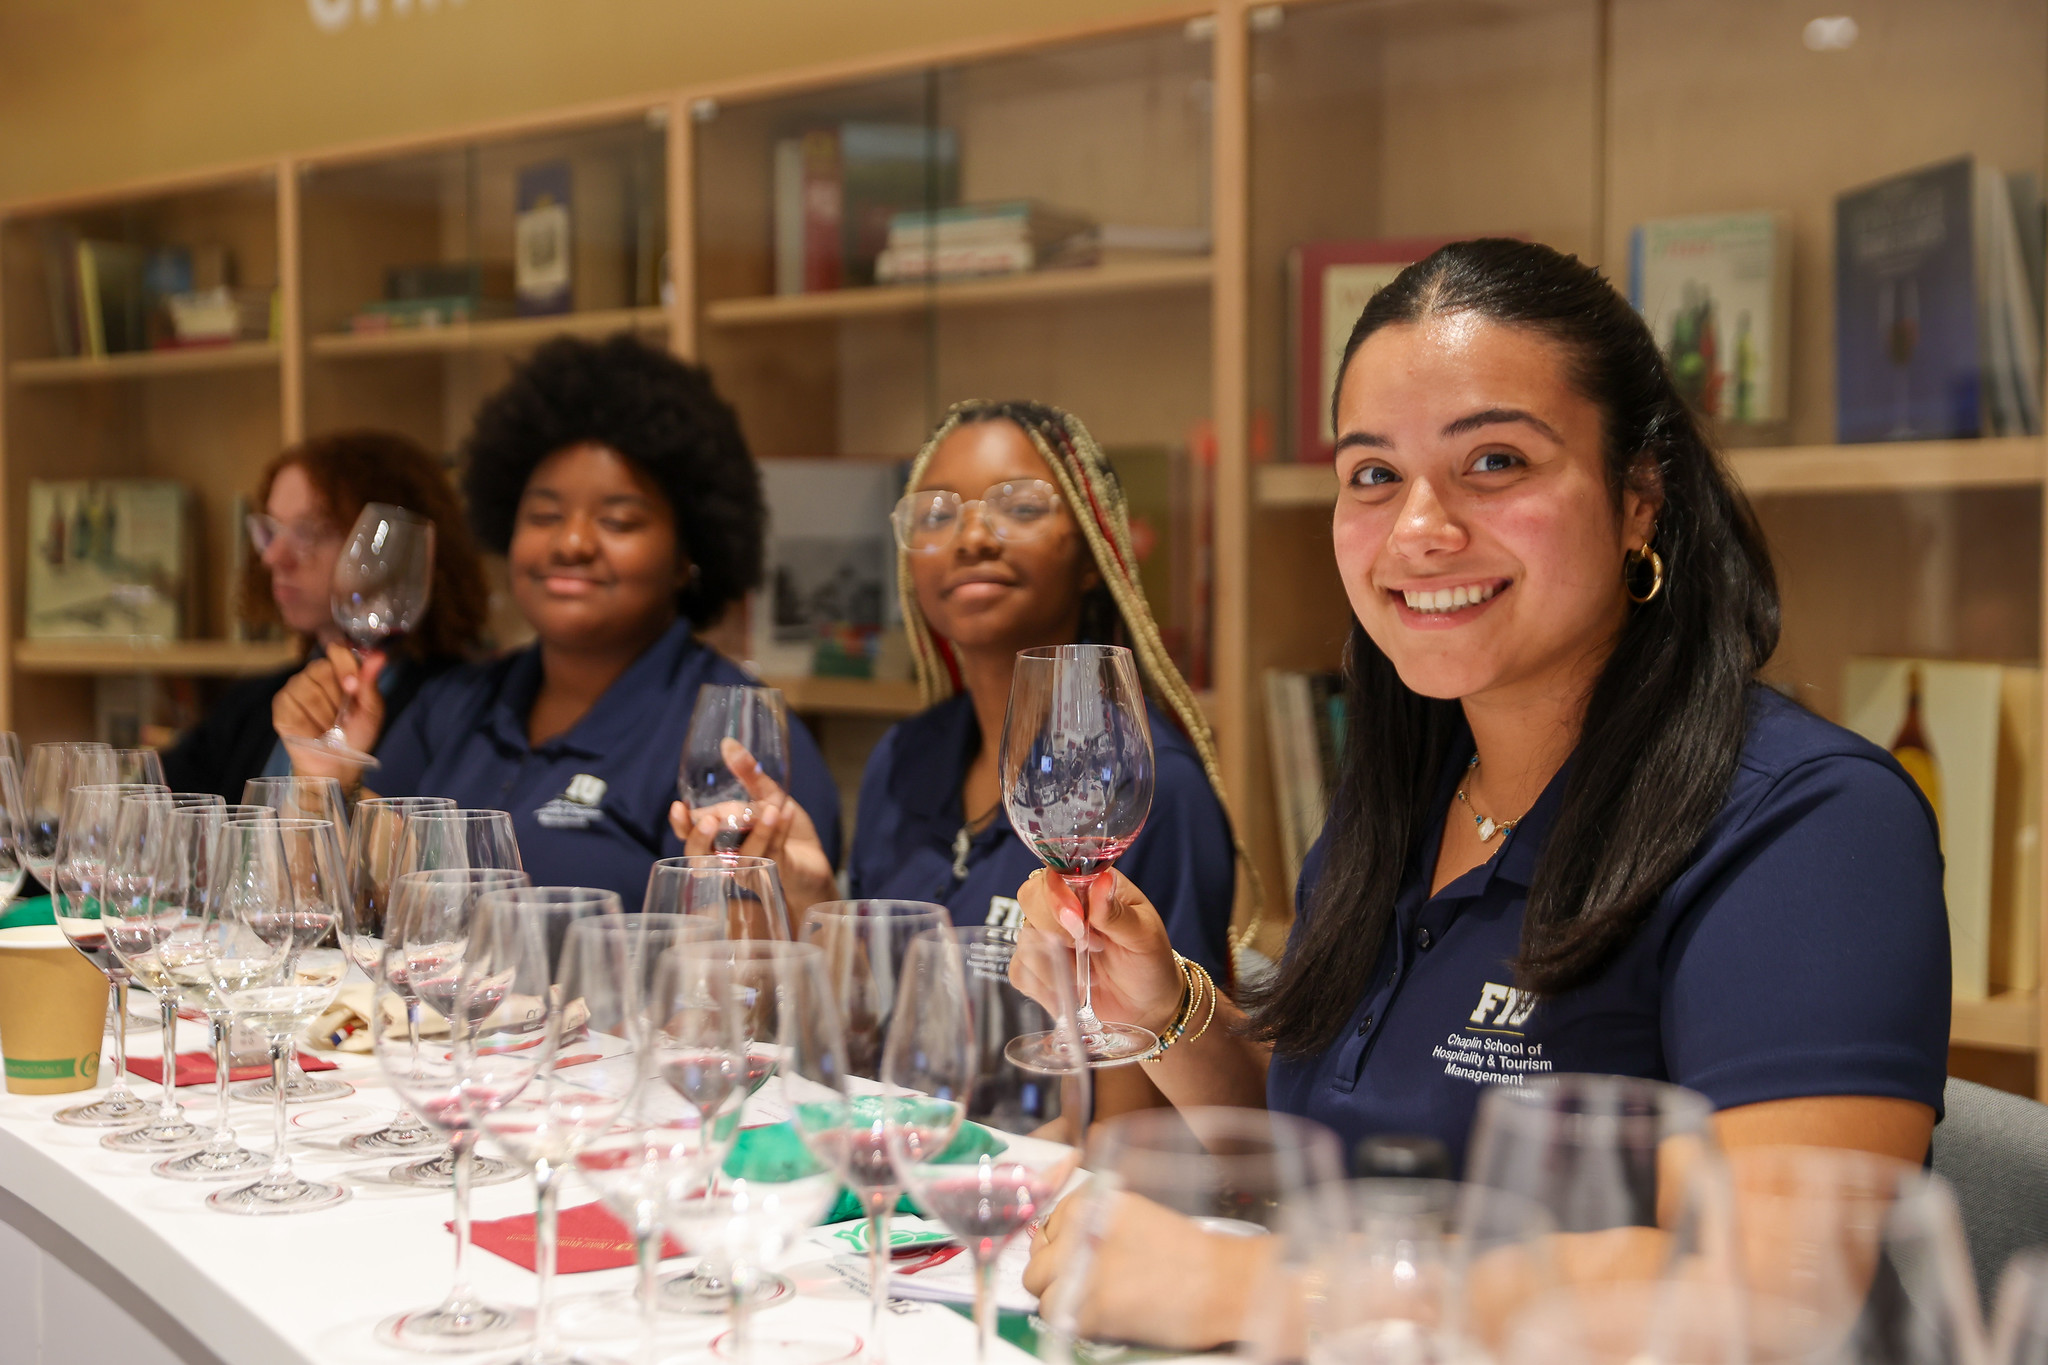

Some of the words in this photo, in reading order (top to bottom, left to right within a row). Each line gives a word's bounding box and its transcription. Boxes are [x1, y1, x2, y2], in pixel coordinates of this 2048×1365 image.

[1447, 1033, 1482, 1049] Chaplin
[1483, 1037, 1524, 1055] School
[1527, 1043, 1543, 1055] of
[1432, 1045, 1485, 1067] Hospitality
[1487, 1054, 1496, 1068] &
[1499, 1055, 1553, 1071] Tourism
[1444, 1062, 1524, 1085] Management
